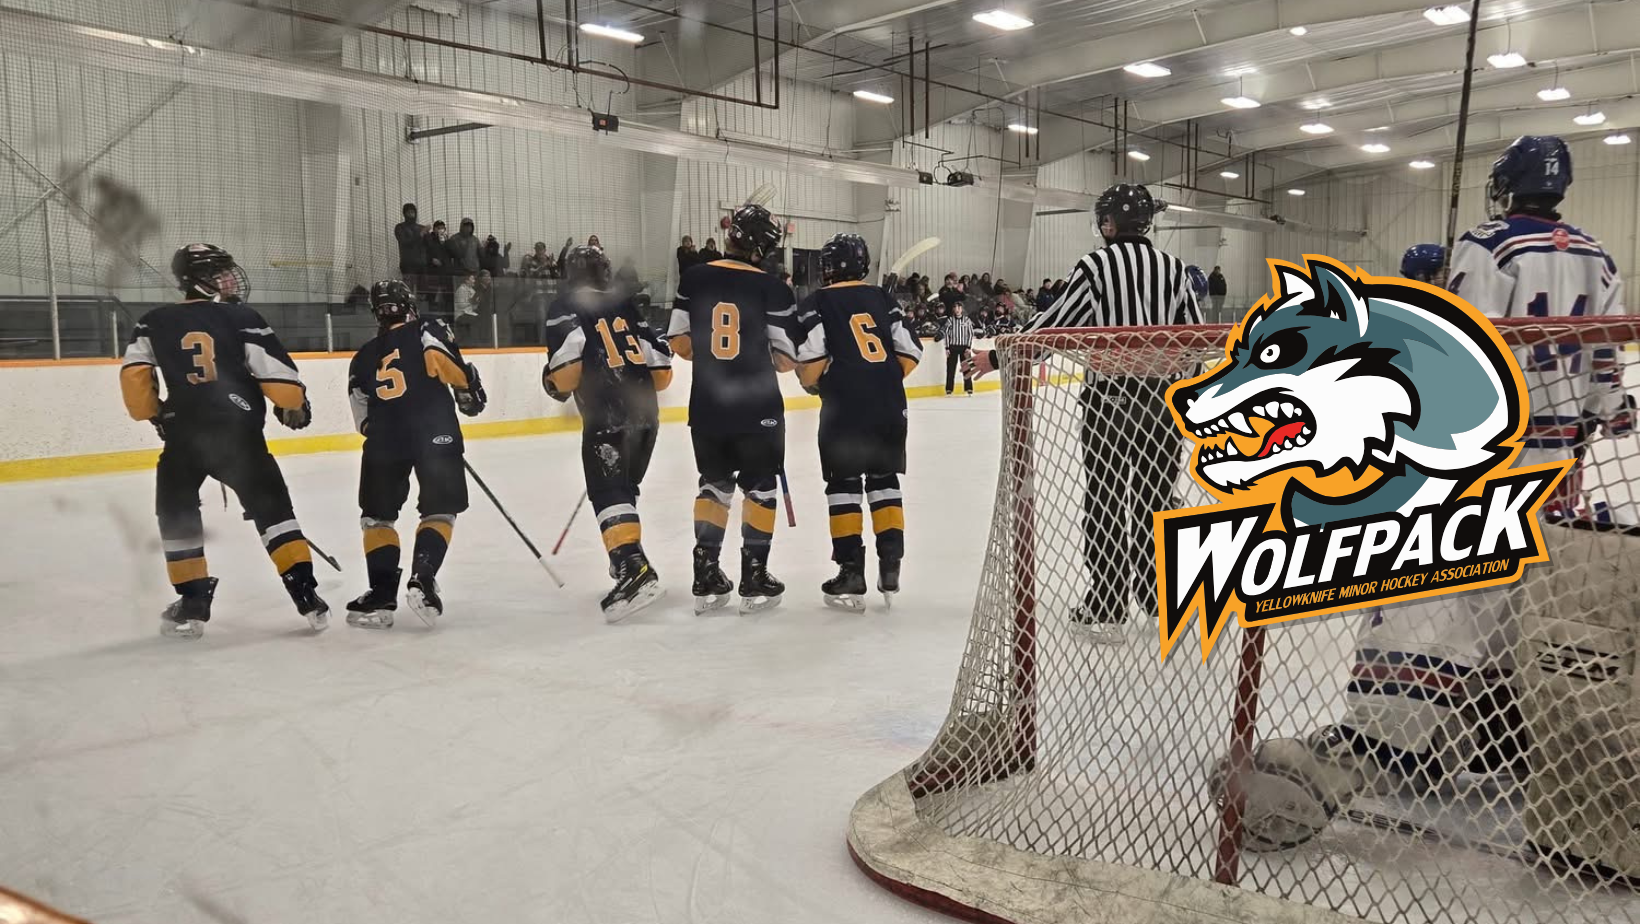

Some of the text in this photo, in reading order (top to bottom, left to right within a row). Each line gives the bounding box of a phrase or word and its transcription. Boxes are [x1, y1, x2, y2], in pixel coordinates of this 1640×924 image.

[1544, 161, 1560, 176] 14
[595, 316, 647, 368] 13
[711, 302, 740, 360] 8
[849, 312, 887, 363] 6
[181, 331, 218, 385] 3
[375, 348, 407, 401] 5
